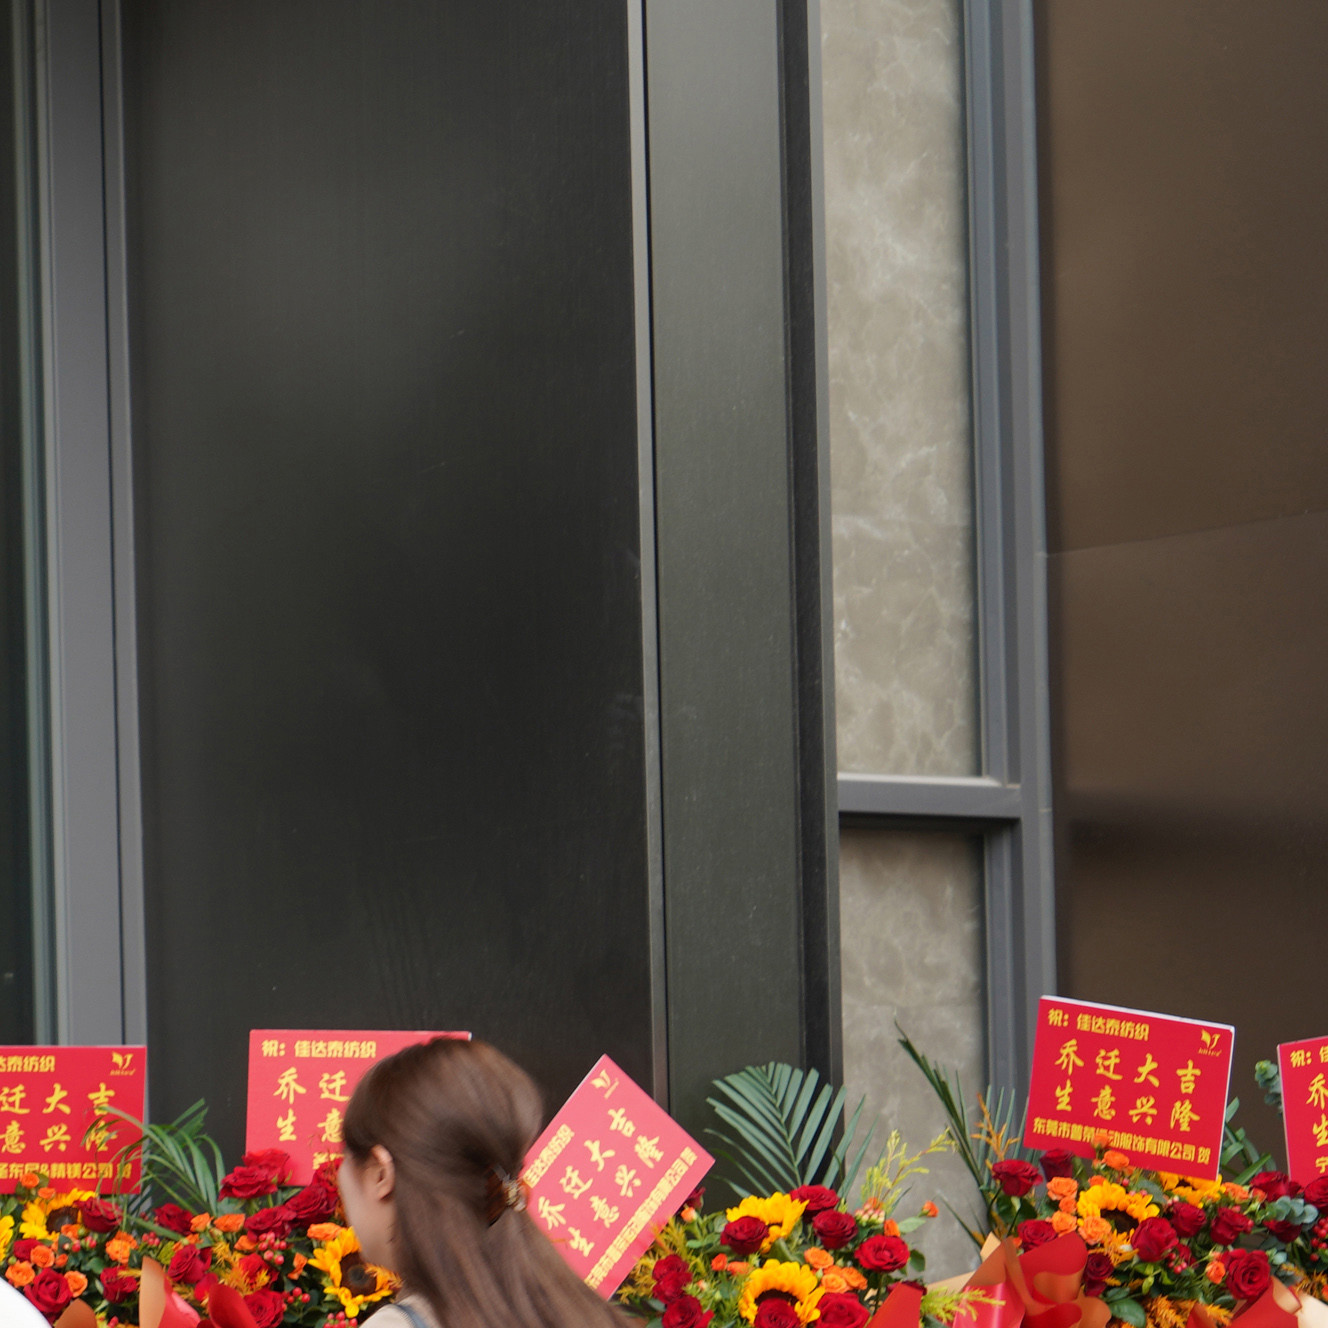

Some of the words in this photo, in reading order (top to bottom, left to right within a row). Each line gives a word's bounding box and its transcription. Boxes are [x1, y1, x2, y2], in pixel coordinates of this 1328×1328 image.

[1055, 1038, 1202, 1095] 乔迁大吉
[1055, 1078, 1201, 1132] 生意兴隆
